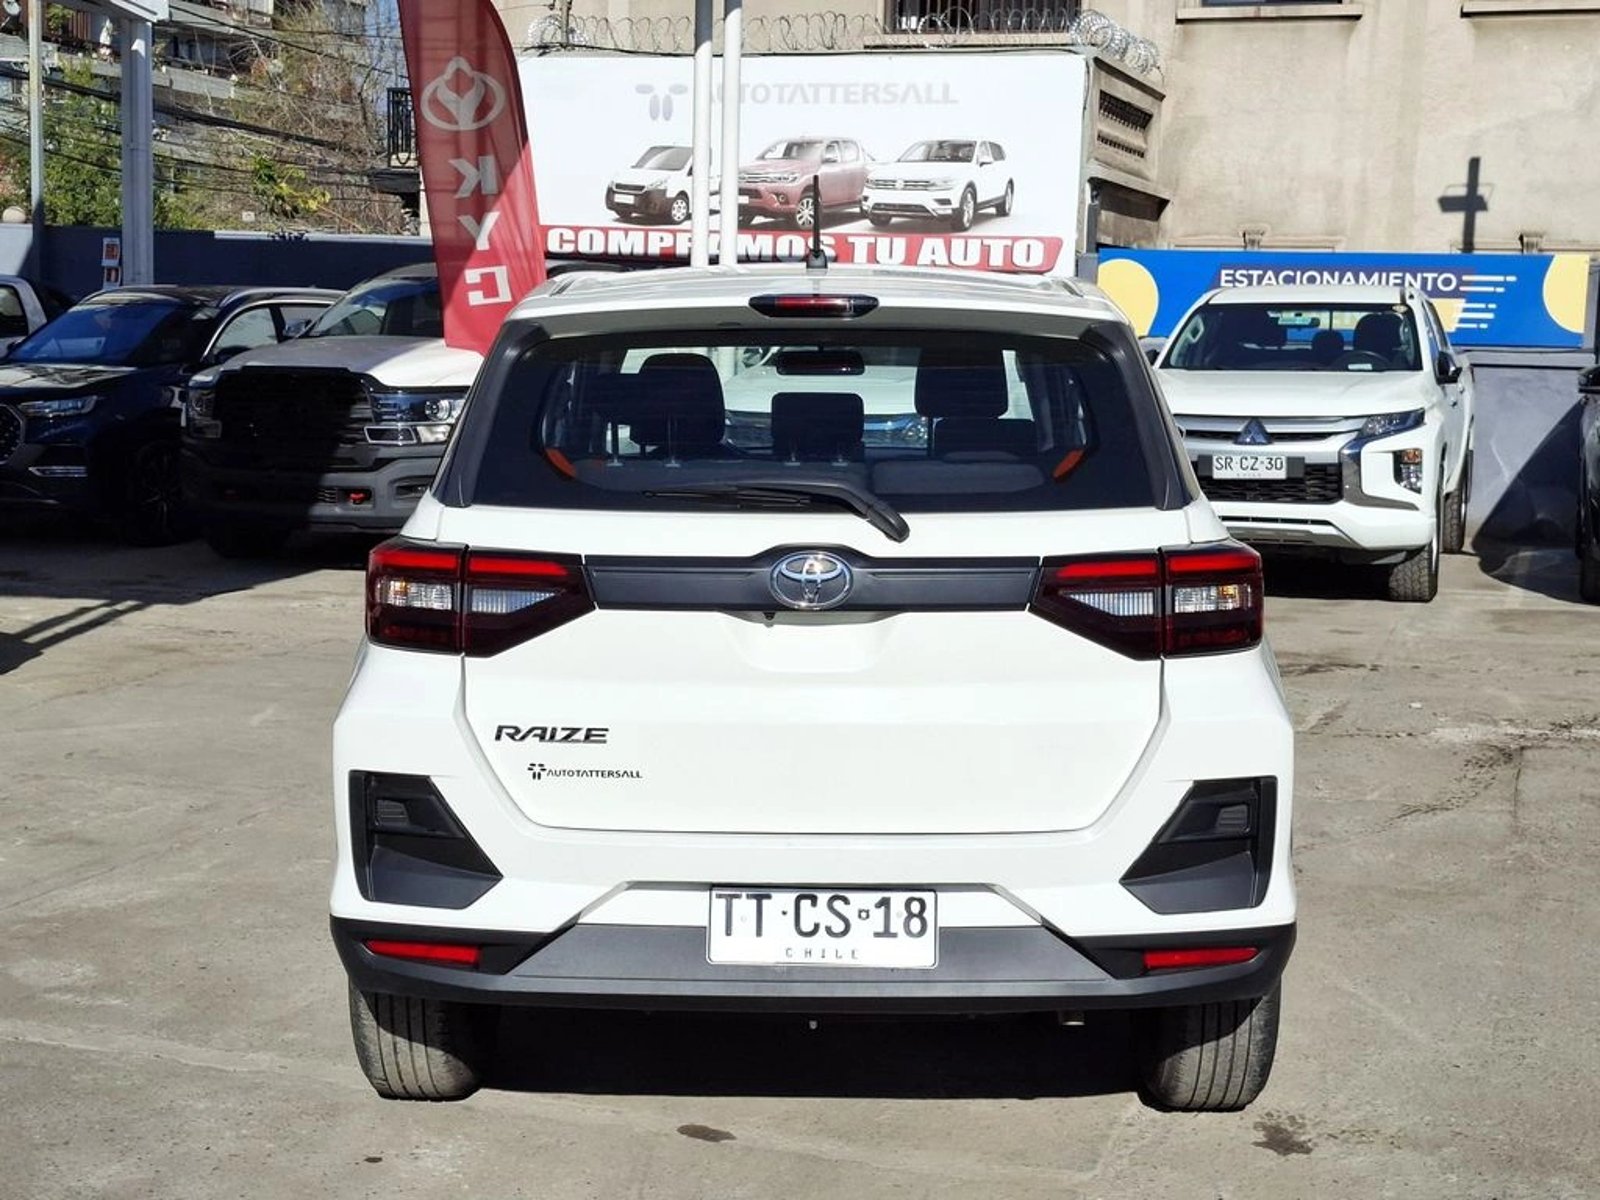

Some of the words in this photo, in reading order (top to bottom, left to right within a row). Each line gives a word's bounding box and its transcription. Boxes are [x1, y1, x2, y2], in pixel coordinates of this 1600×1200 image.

[847, 236, 906, 264] TU
[917, 237, 1044, 269] AUTO
[1219, 269, 1457, 291] ESTACIONAMIENTO
[495, 725, 609, 744] RAIZE
[546, 769, 643, 779] AUTOTATTERSALL
